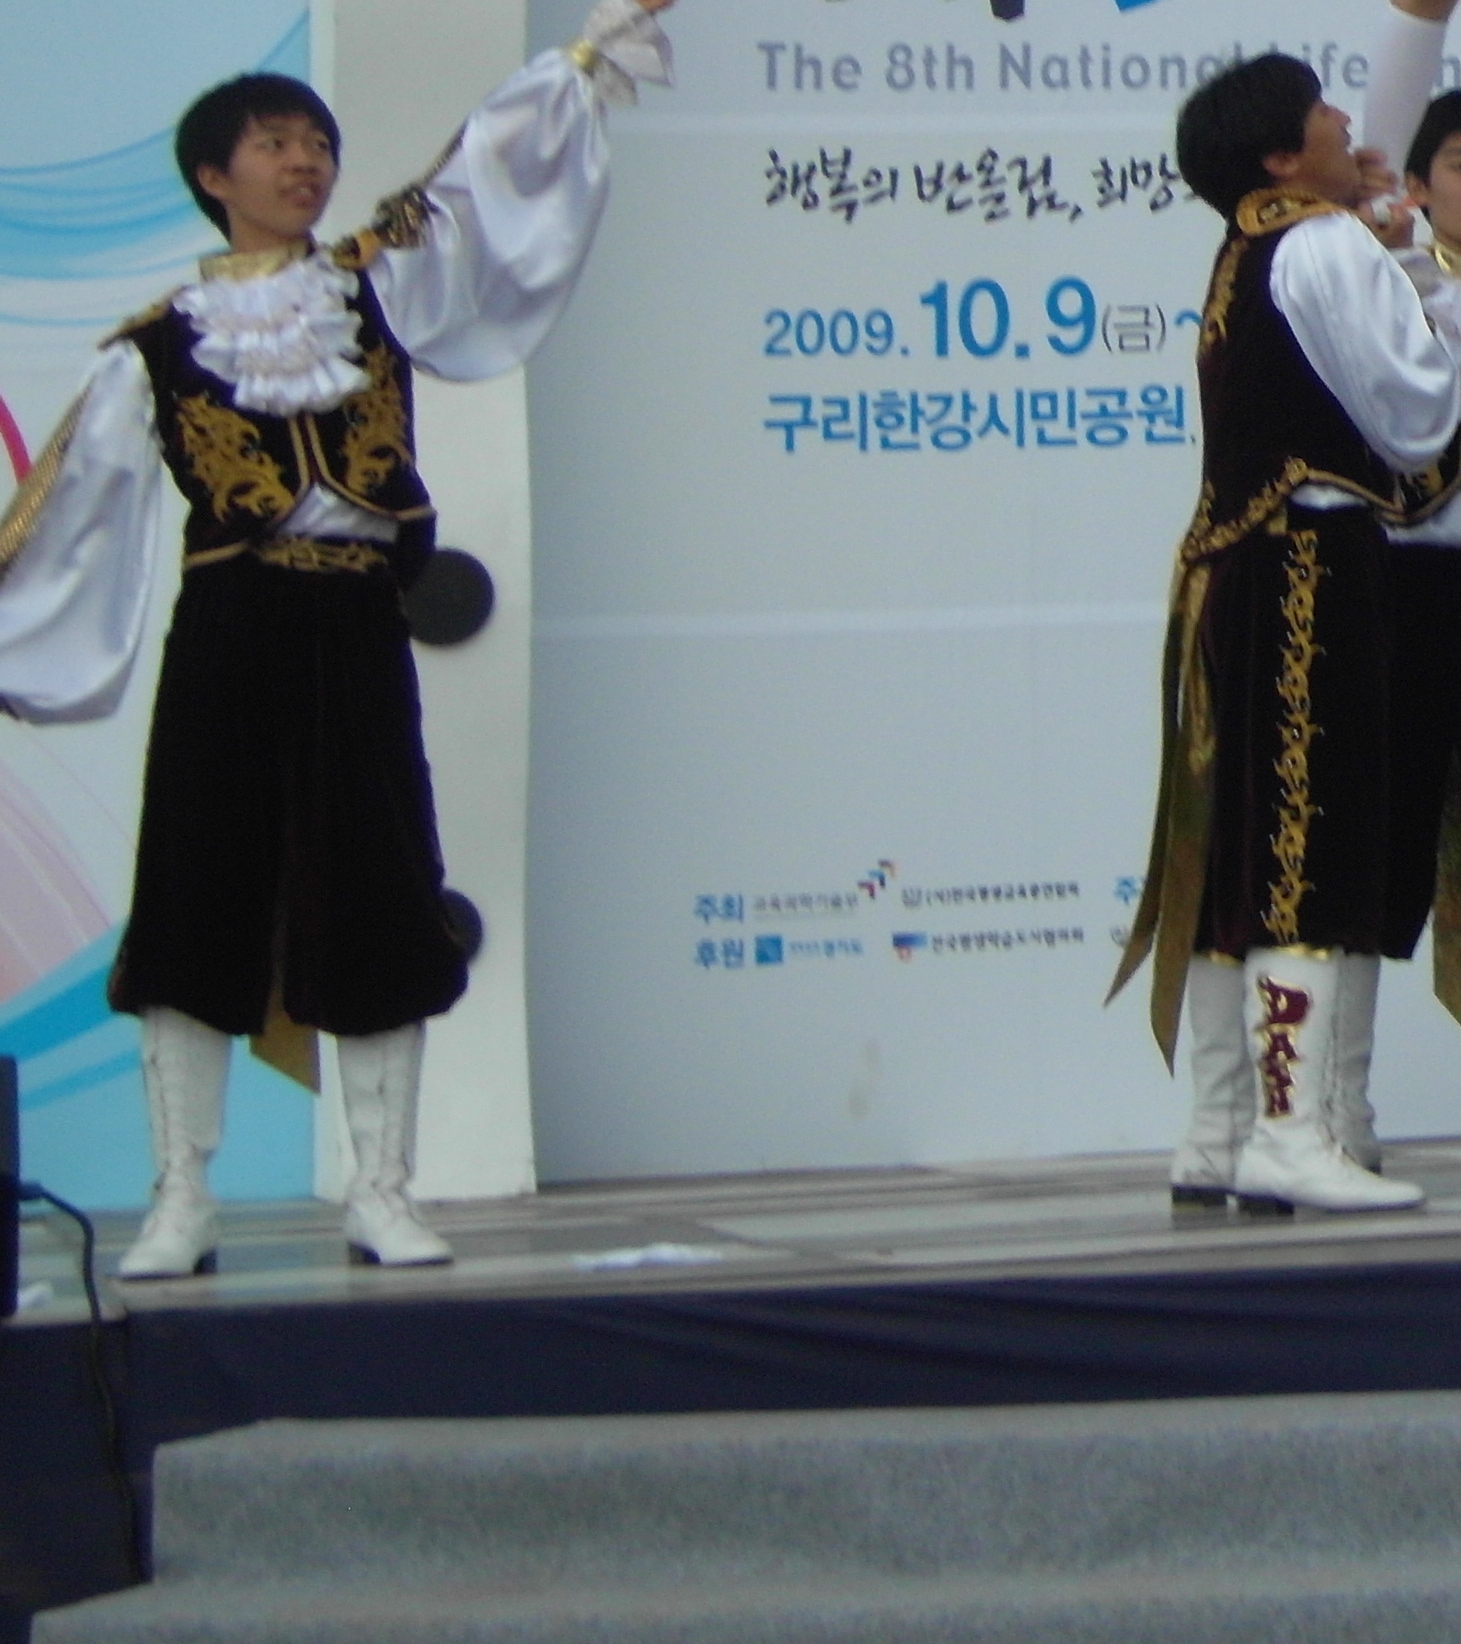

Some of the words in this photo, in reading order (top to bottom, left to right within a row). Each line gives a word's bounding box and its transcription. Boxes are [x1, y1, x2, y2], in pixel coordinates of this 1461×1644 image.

[756, 41, 863, 92] The
[885, 40, 977, 92] 8th
[1091, 152, 1200, 213] 희망
[763, 384, 1187, 454] 구리한강시민공원
